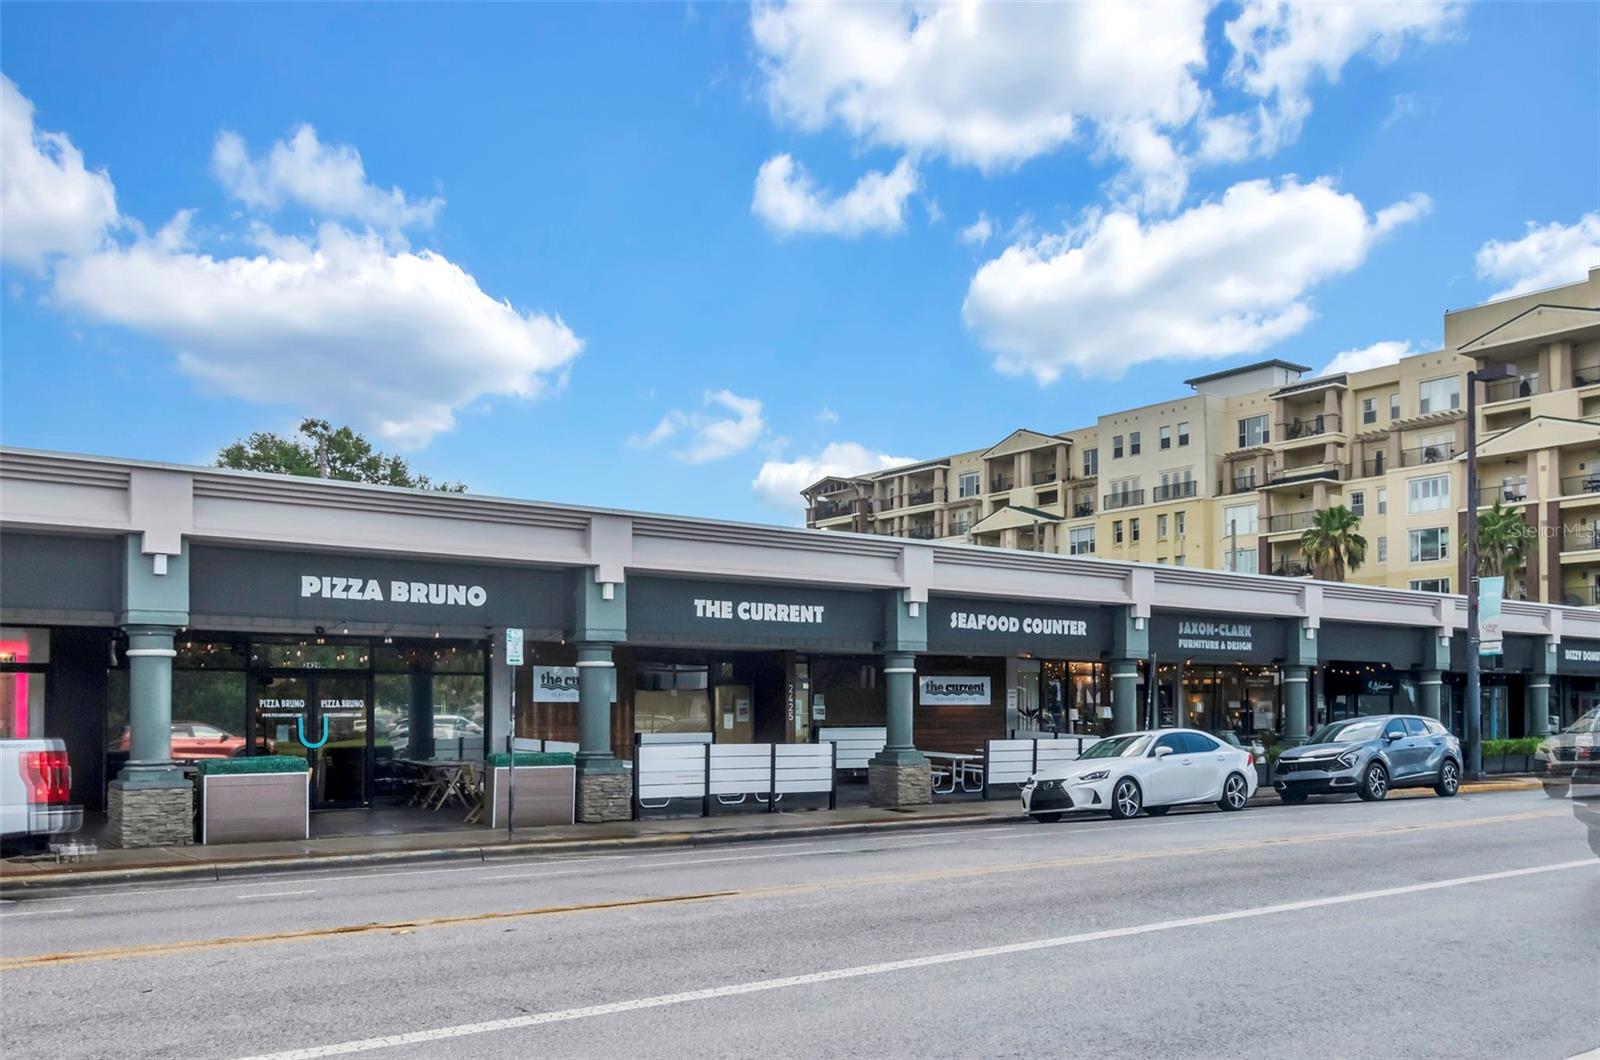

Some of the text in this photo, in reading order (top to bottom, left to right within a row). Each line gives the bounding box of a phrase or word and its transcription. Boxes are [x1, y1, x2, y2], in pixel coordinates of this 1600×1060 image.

[301, 575, 487, 607] PIZZA BRUNO
[694, 598, 824, 623] THE CURRENT
[951, 612, 1088, 636] SEAFOOD COUNTER
[1178, 622, 1252, 637] SAXON-CLARK
[1178, 639, 1252, 651] FURNITURE & DESIGN
[541, 671, 563, 685] the
[926, 680, 985, 693] the current
[259, 699, 305, 708] PIZZA BRUNO
[320, 699, 364, 708] PIZZA BRUNO
